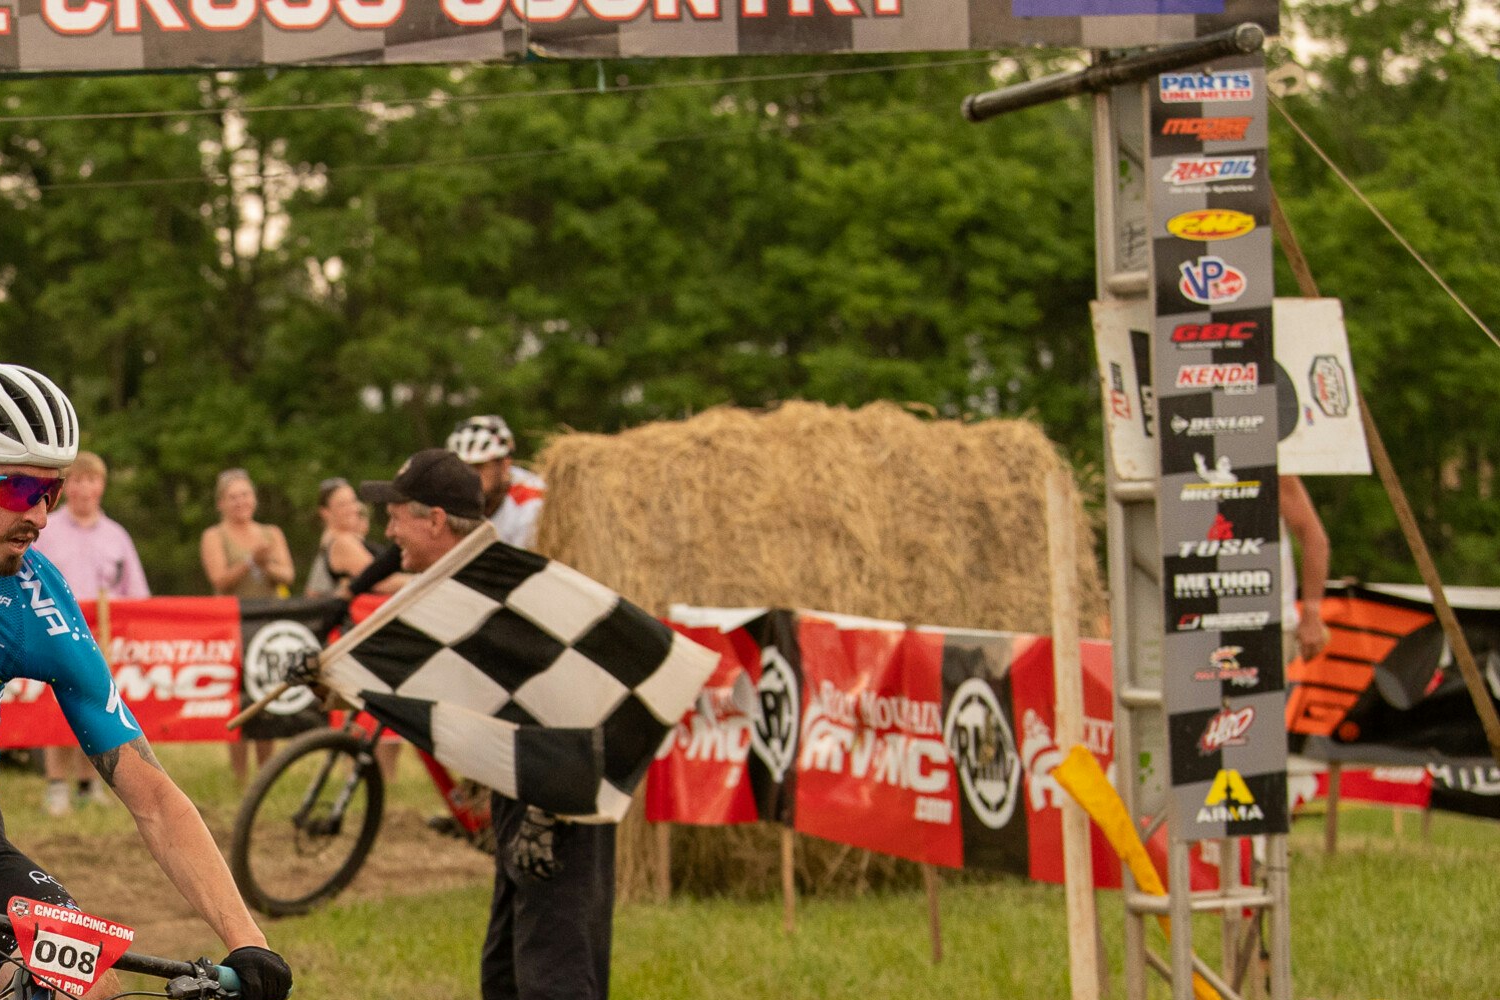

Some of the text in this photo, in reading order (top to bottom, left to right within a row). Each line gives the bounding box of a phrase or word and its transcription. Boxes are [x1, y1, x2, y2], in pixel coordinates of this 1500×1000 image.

[1161, 75, 1250, 90] PARTS
[1171, 160, 1252, 181] AMSOIL
[1171, 321, 1258, 342] GBC
[1178, 364, 1256, 385] KENDA
[1179, 538, 1266, 559] TUSK
[1174, 570, 1271, 591] METHOD
[33, 903, 135, 942] GNCCRACING.COM
[34, 939, 96, 975] 008
[63, 981, 84, 996] PRO
